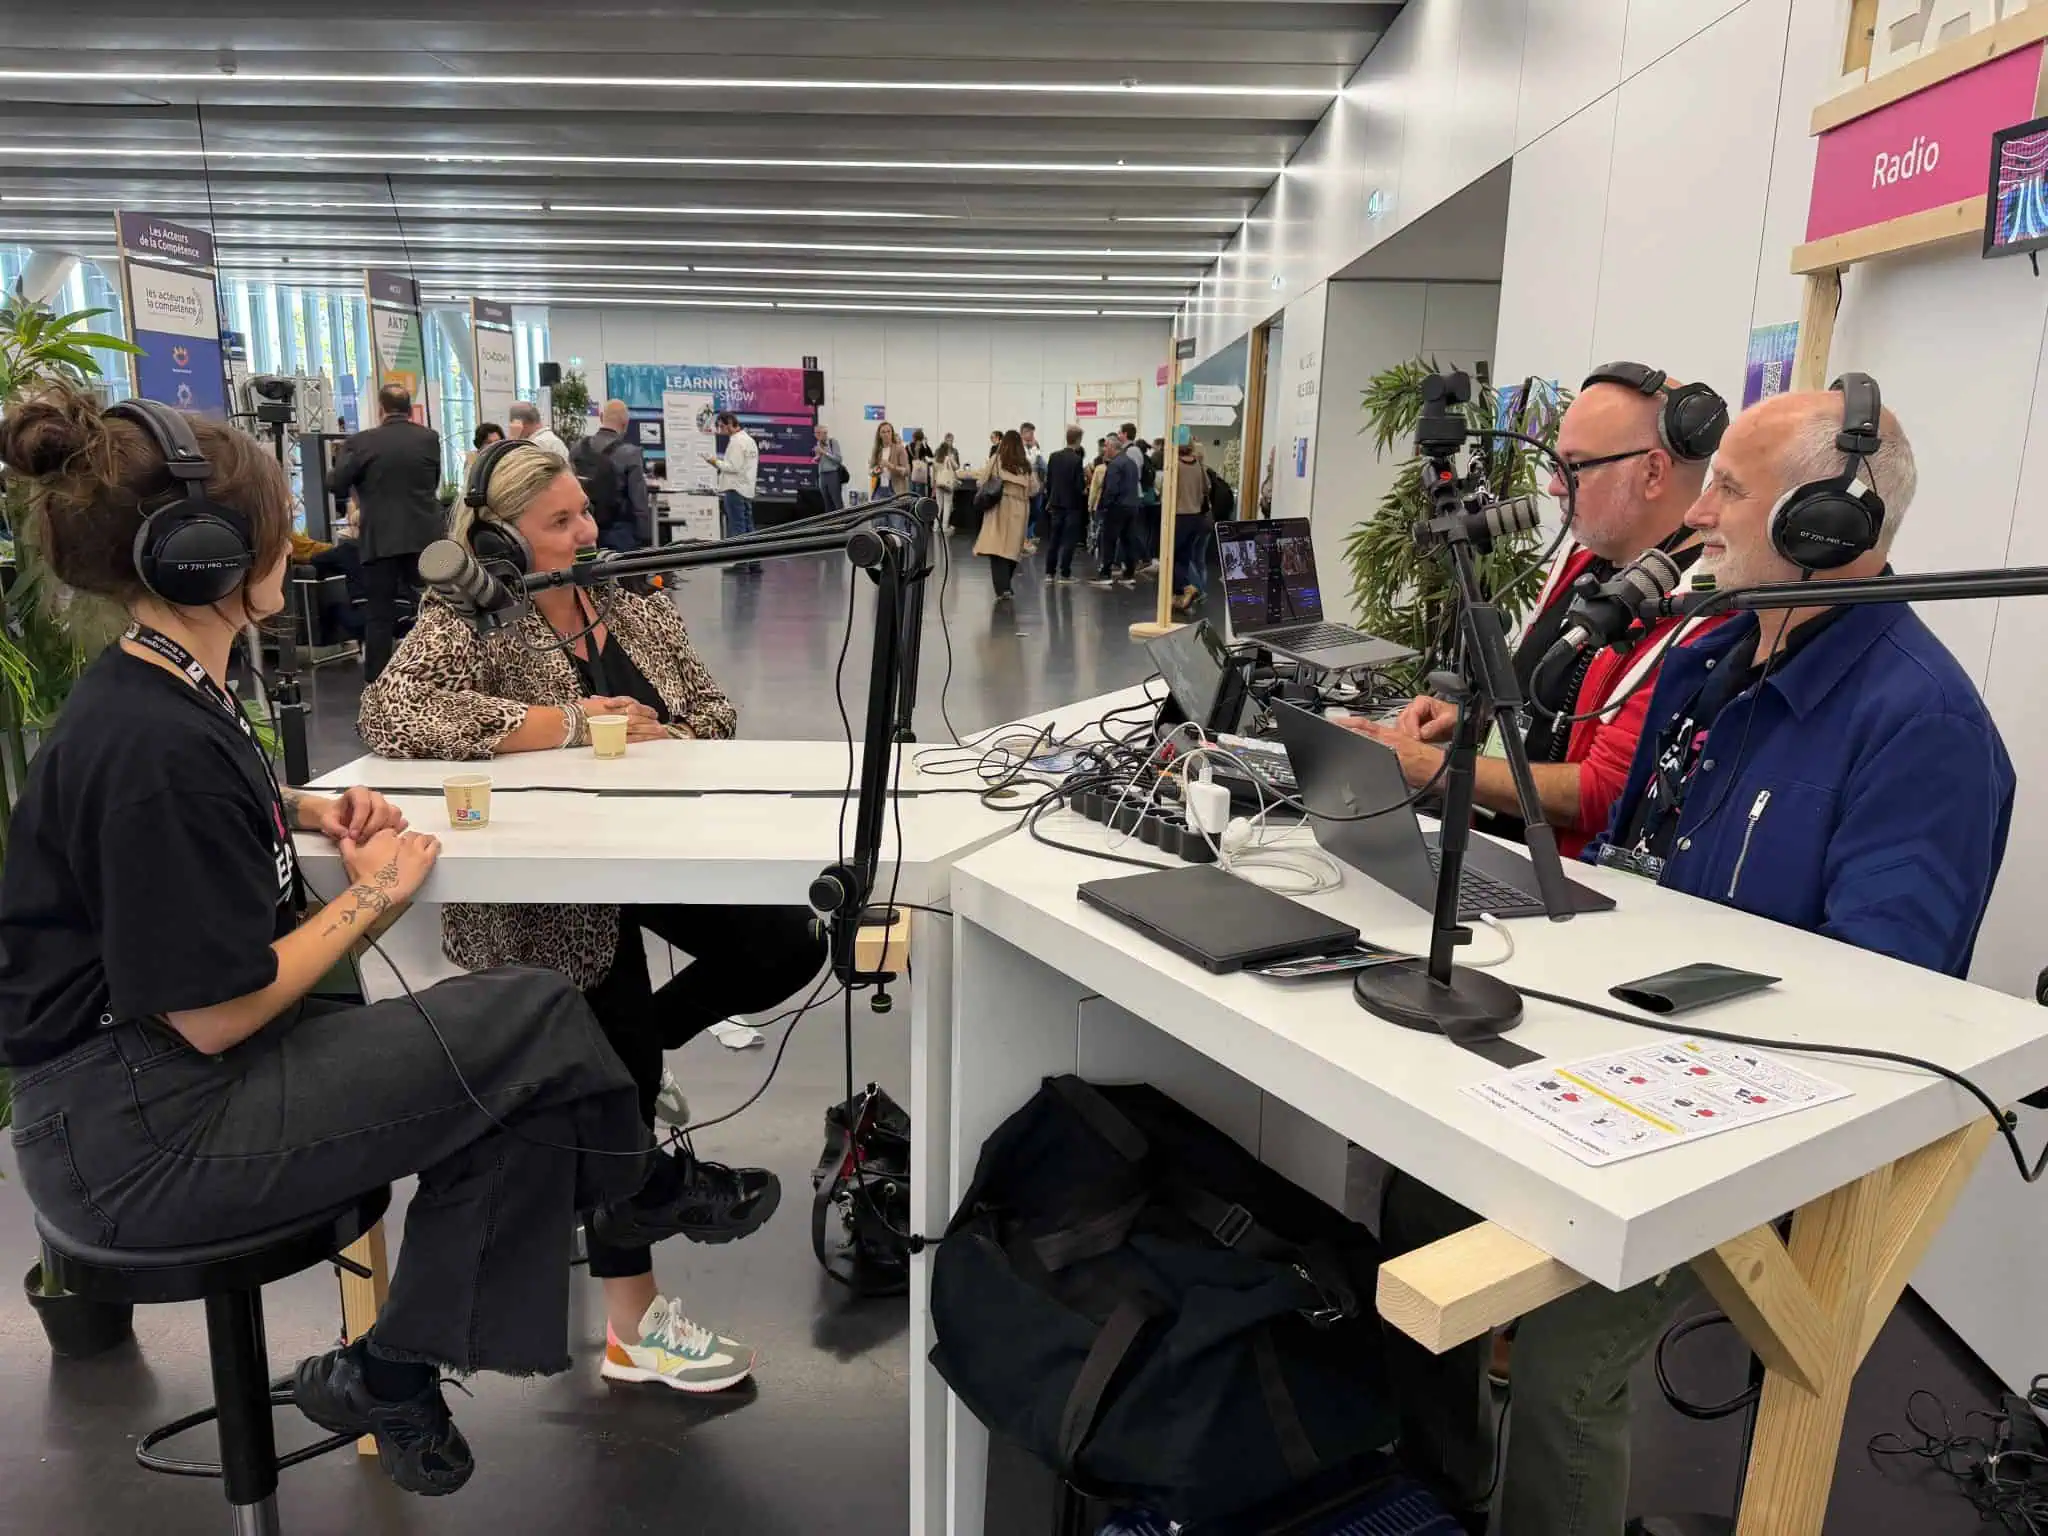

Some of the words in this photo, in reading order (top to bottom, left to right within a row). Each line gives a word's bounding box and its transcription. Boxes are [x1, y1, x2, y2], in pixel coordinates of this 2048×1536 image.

[1872, 135, 1939, 190] Radio
[148, 223, 162, 238] Les
[162, 228, 189, 244] Acteurs
[139, 234, 149, 247] de
[149, 237, 157, 249] la
[157, 239, 200, 258] Compétence
[145, 287, 157, 298] les
[158, 289, 185, 303] acteurs
[146, 297, 154, 309] la
[387, 313, 409, 331] AKTO
[666, 375, 740, 391] LEARNING
[719, 390, 754, 402] SHOW
